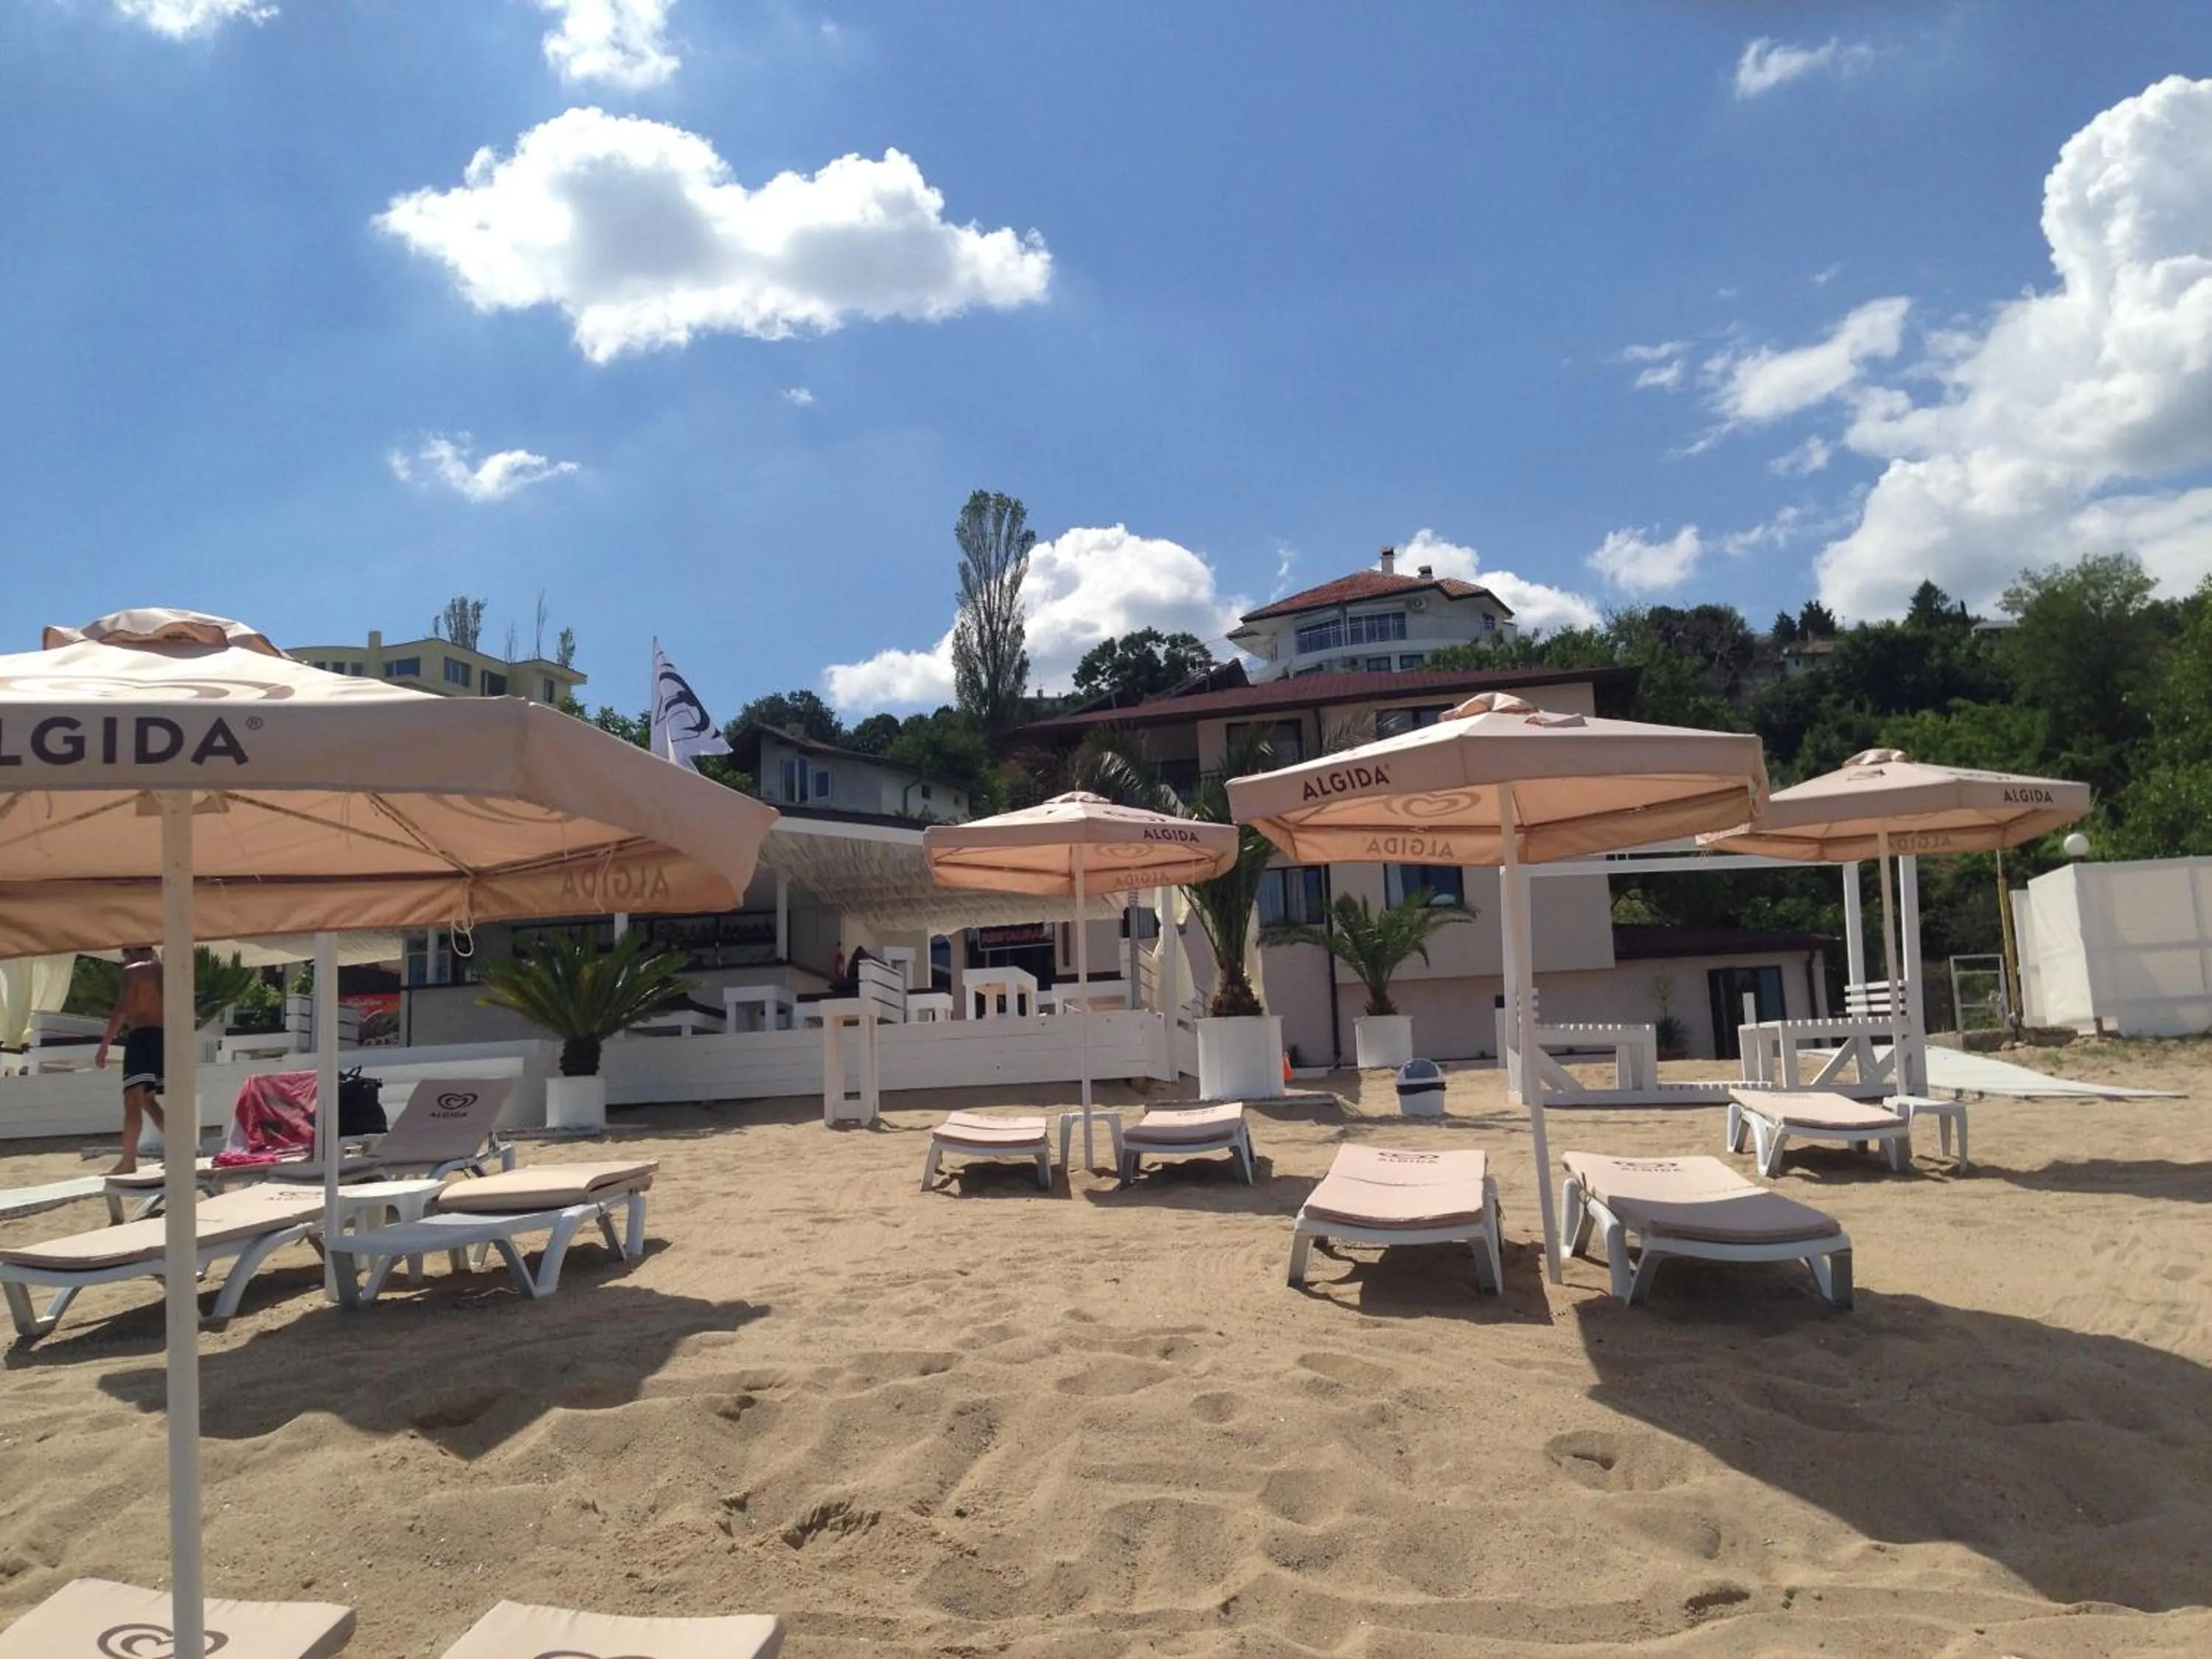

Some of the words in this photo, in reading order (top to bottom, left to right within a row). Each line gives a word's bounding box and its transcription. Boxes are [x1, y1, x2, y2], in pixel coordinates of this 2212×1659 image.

[1303, 765, 1391, 801] ALGIDA
[2004, 788, 2053, 803] ALGIDA
[1144, 828, 1200, 842] ALGIDA
